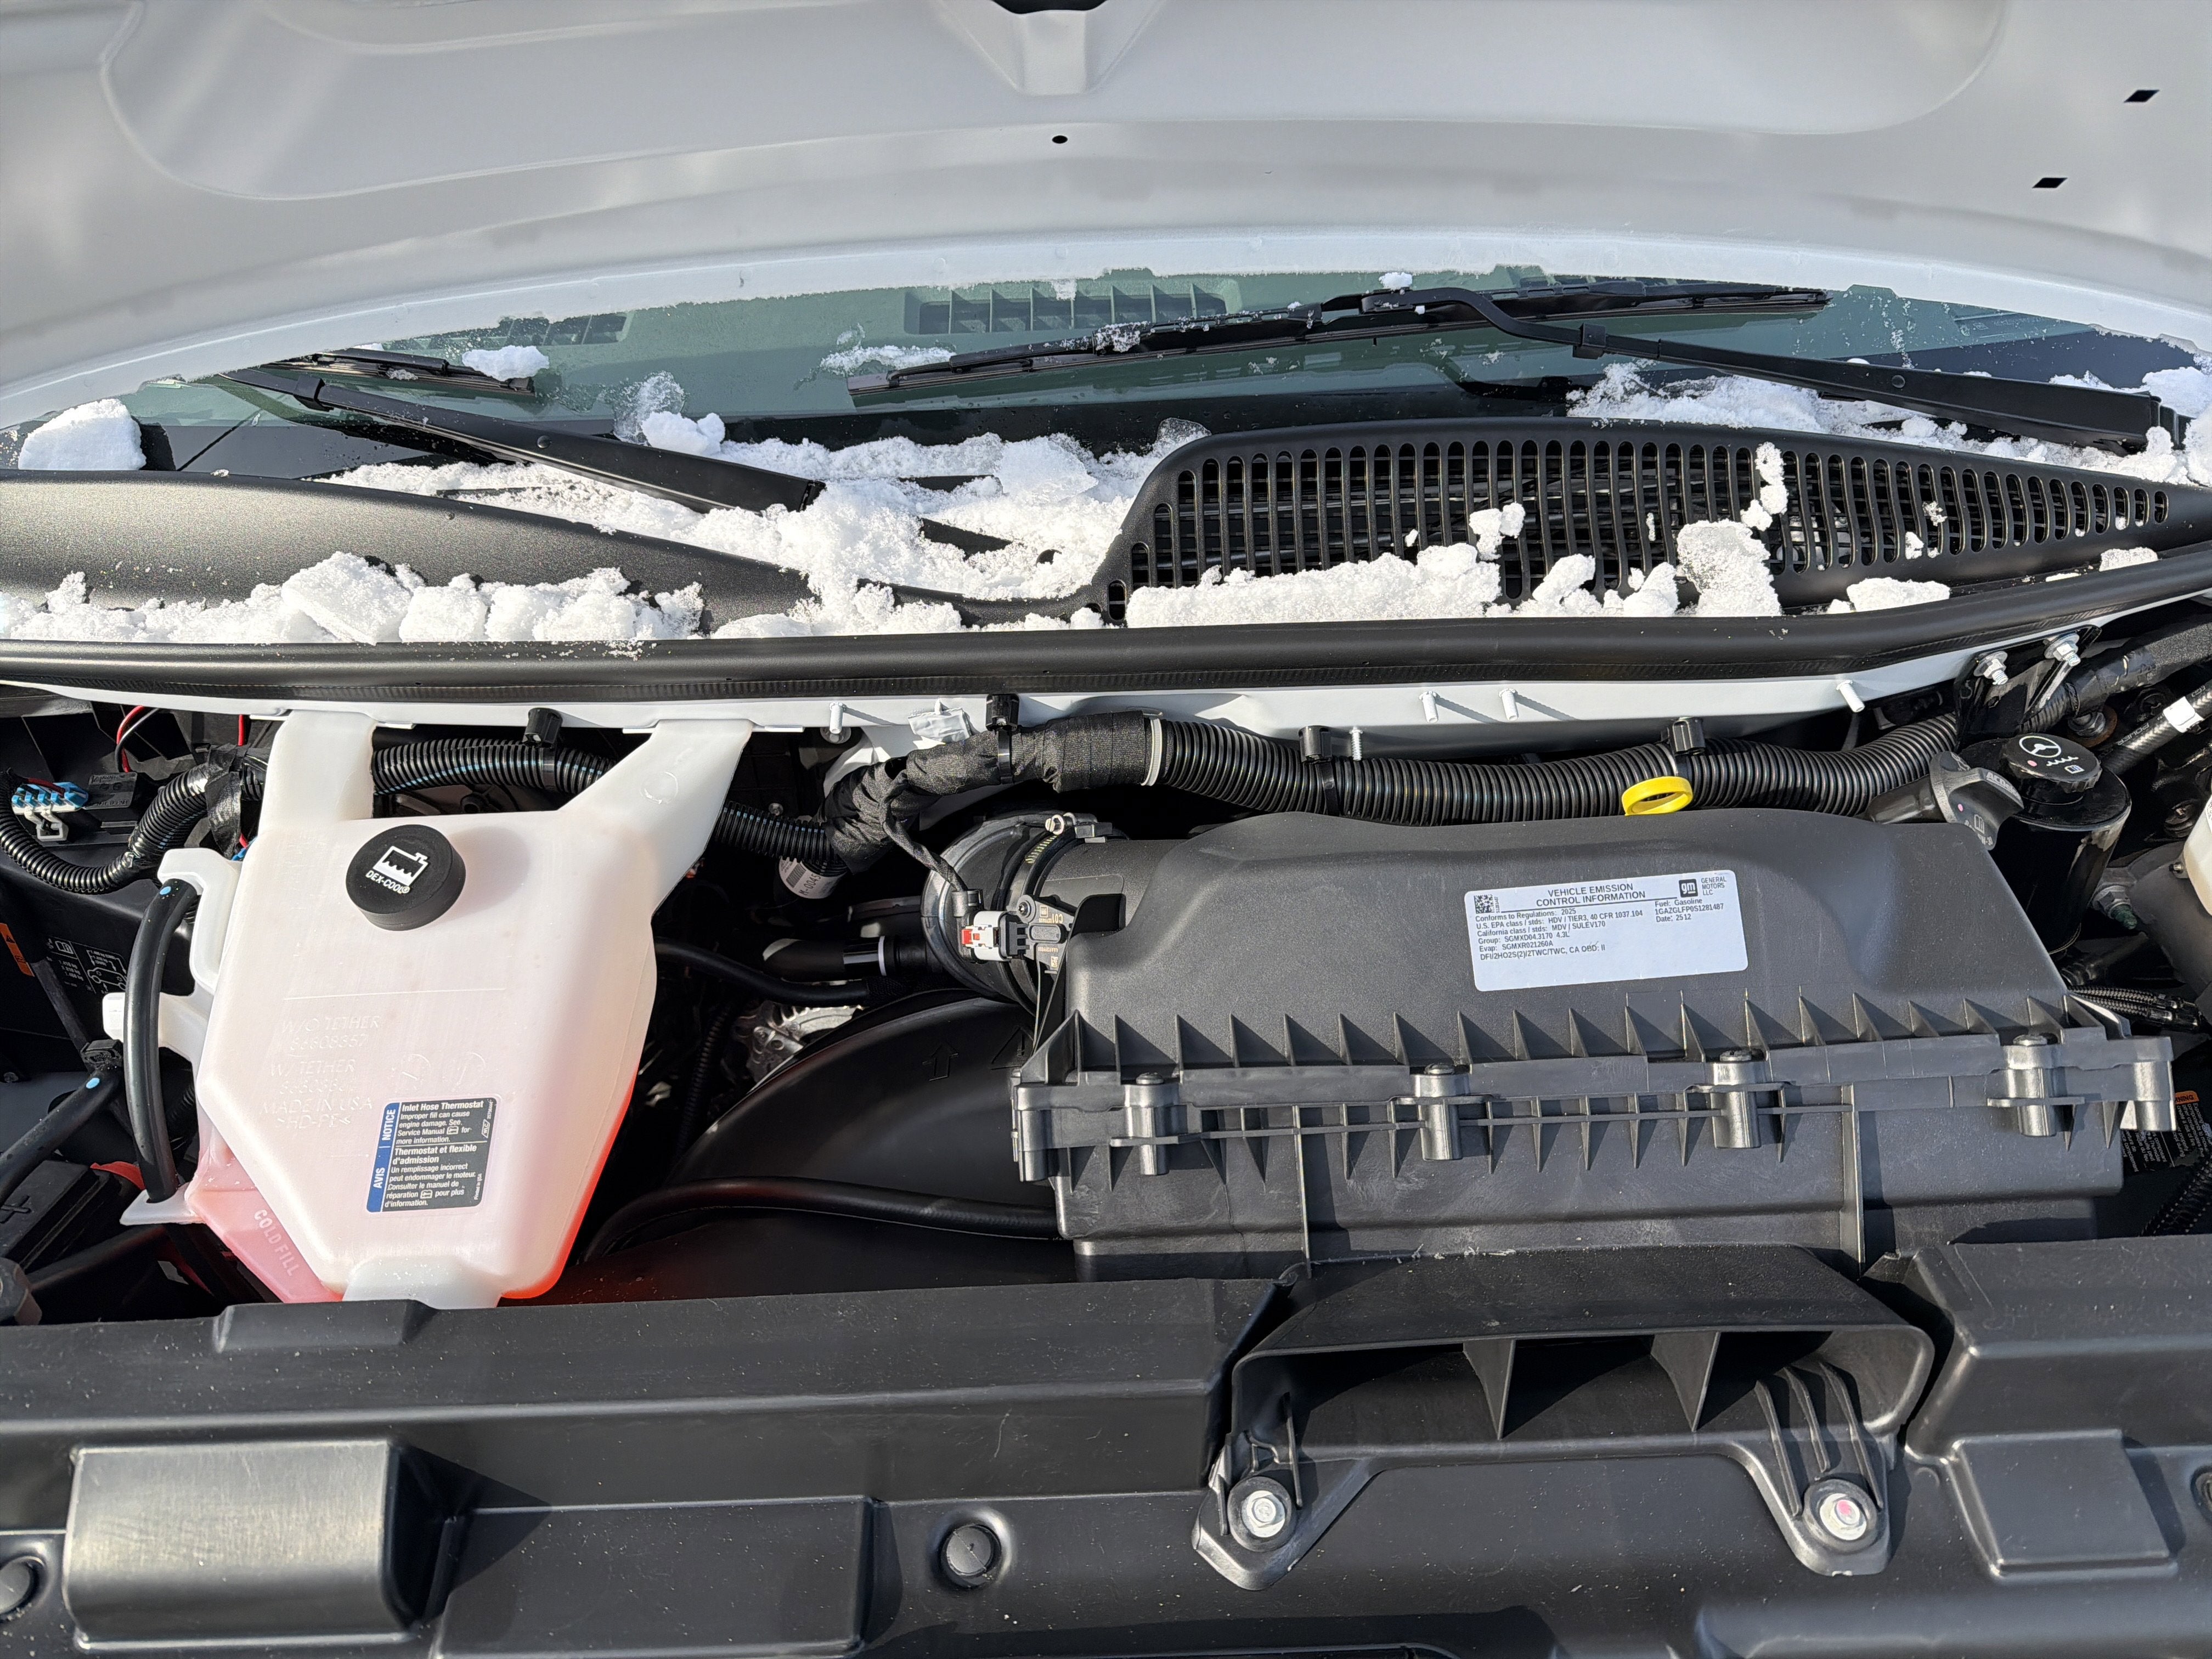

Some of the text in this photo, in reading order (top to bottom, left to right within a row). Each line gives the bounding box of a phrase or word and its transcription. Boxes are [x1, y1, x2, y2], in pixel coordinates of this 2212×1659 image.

[2118, 723, 2149, 745] POWER
[1548, 883, 1633, 897] VEHICLE EMISSION
[1680, 881, 1697, 895] gm
[1536, 891, 1646, 906] CONTROL INFORMATION
[1517, 911, 1556, 919] Regulations:
[1615, 910, 1643, 918] 1037.104
[1572, 921, 1606, 929] SULEV170
[1502, 940, 1553, 950] SGMXR021260A
[324, 1015, 381, 1030] TETHER
[300, 1059, 356, 1075] TETHER
[259, 1096, 373, 1114] MADE IN USA
[402, 1101, 484, 1112] Inlet Hose Thermostat
[400, 1112, 428, 1121] Improper
[382, 1109, 396, 1141] NOTICE
[421, 1119, 447, 1128] damage.
[397, 1128, 420, 1137] Service
[395, 1147, 438, 1155] Thermostat
[393, 1155, 439, 1165] d'admission
[373, 1167, 385, 1188] AVIS
[405, 1173, 445, 1182] endommager
[387, 1182, 417, 1190] Consulter
[386, 1190, 418, 1199] réparation
[385, 1199, 428, 1208] d'information.
[254, 1209, 300, 1277] COLD FILL
